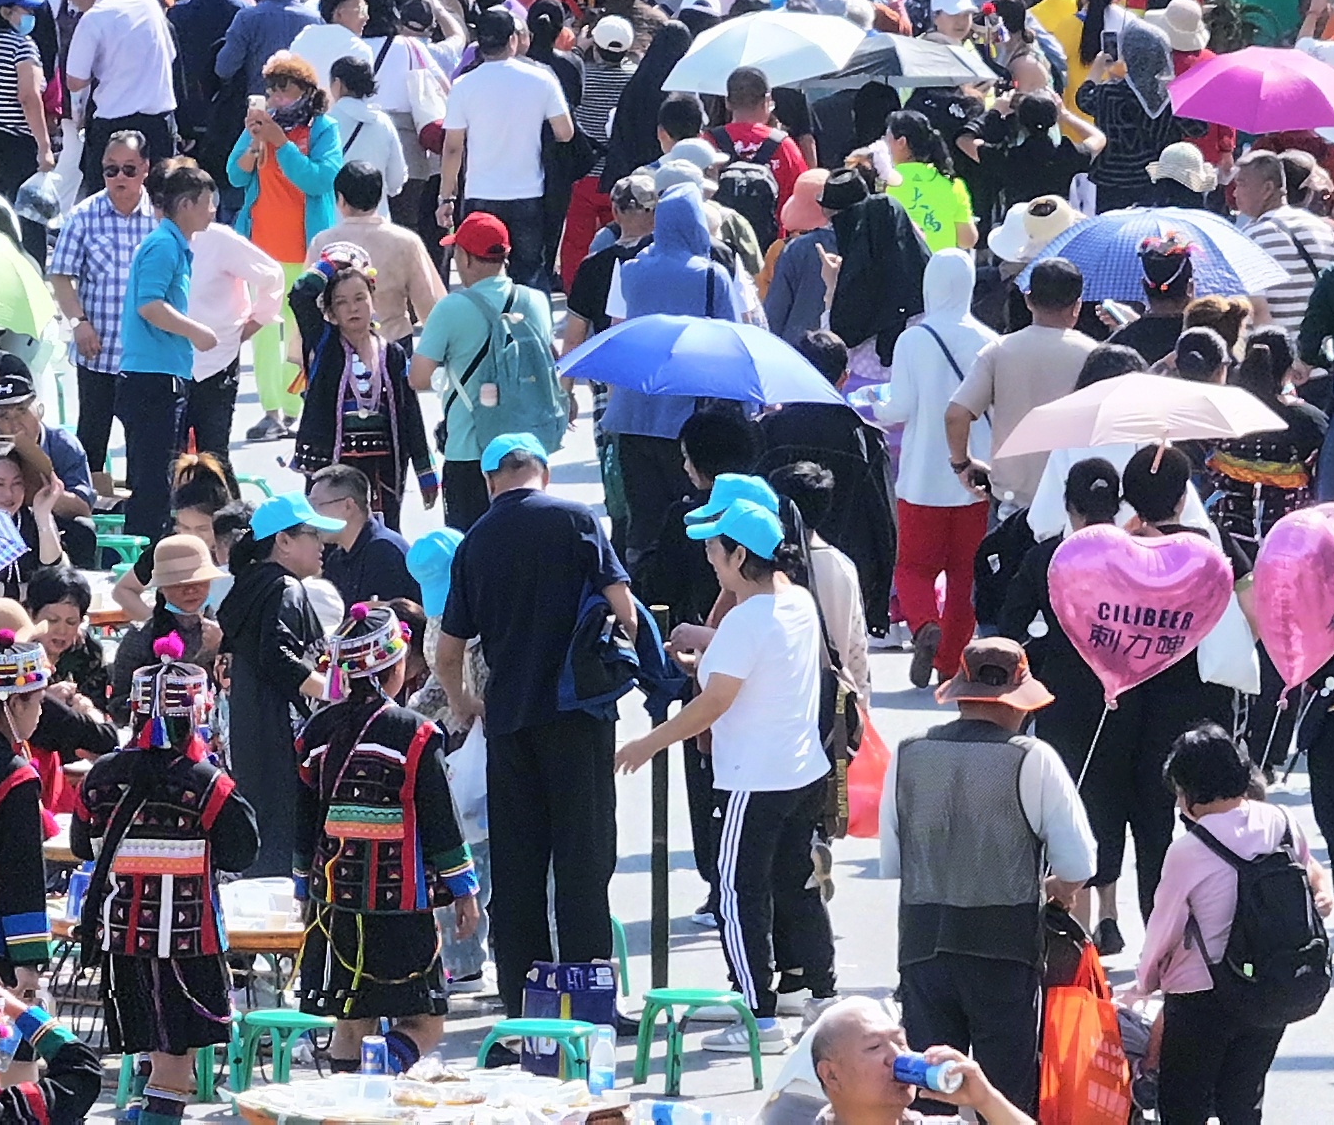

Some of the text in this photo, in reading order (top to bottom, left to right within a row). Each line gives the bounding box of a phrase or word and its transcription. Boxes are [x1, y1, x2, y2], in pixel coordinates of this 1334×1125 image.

[1098, 601, 1194, 631] CILIBEER
[1087, 623, 1186, 660] 刺力啤
